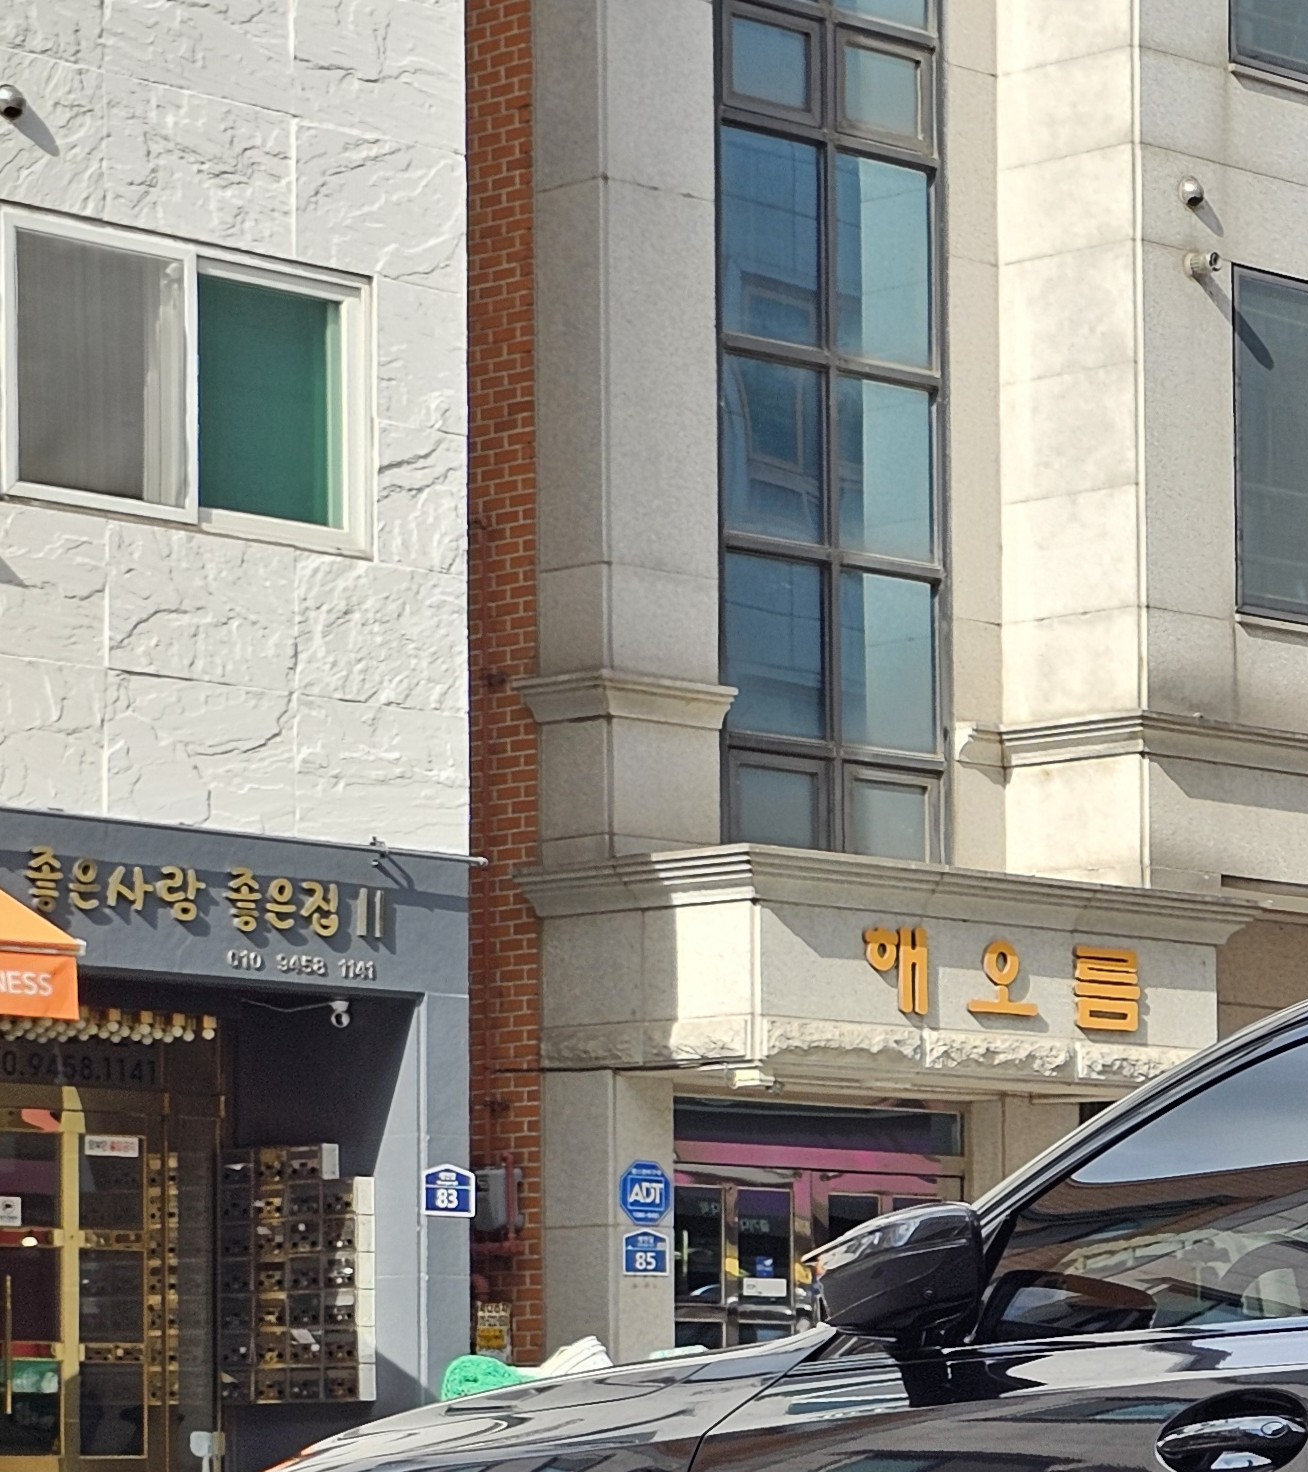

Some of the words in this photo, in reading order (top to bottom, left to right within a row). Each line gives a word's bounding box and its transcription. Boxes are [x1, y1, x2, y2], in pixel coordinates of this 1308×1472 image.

[25, 845, 206, 922] 좋은사랑
[223, 866, 340, 938] 좋은집
[227, 949, 262, 970] 010
[276, 952, 326, 976] 9458
[337, 957, 376, 980] 1141
[863, 926, 1141, 1032] 해오름
[435, 1188, 459, 1209] 83
[629, 1181, 664, 1204] ADT
[635, 1252, 656, 1270] 85
